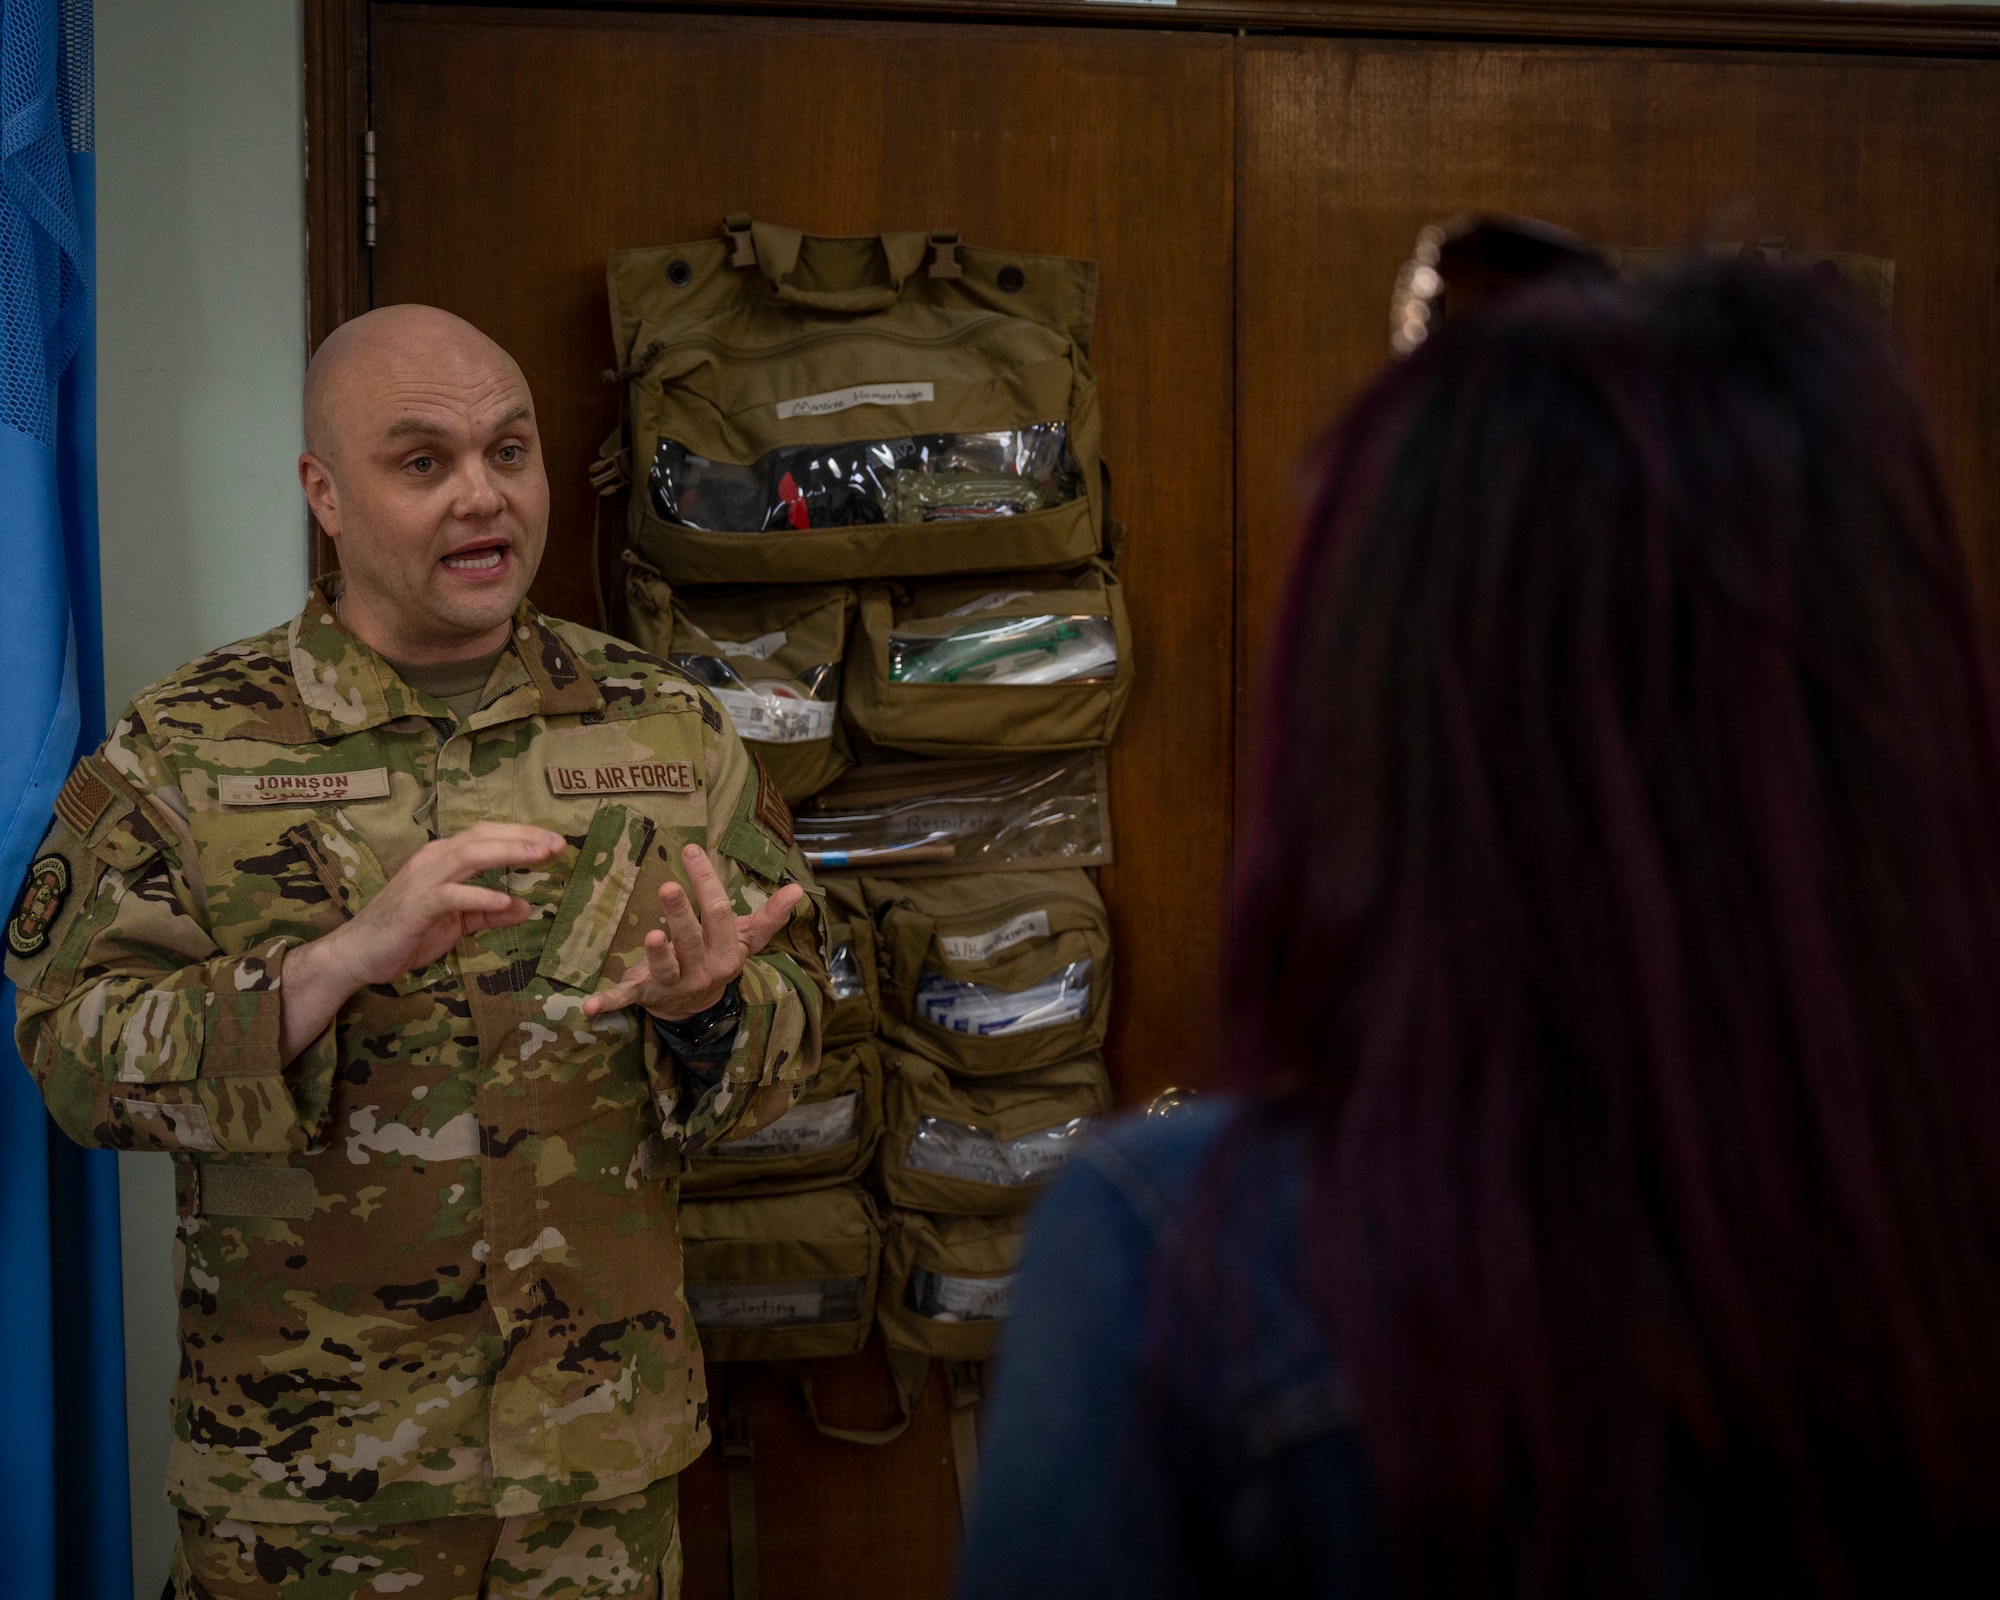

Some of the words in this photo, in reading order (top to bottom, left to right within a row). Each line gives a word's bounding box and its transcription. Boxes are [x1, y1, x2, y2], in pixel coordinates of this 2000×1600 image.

[792, 399, 845, 414] Massive
[254, 775, 349, 791] JOHNSON
[558, 768, 591, 790] U.S.
[595, 767, 628, 789] AIR
[629, 765, 690, 787] FORCE
[717, 1299, 796, 1319] Splinting
